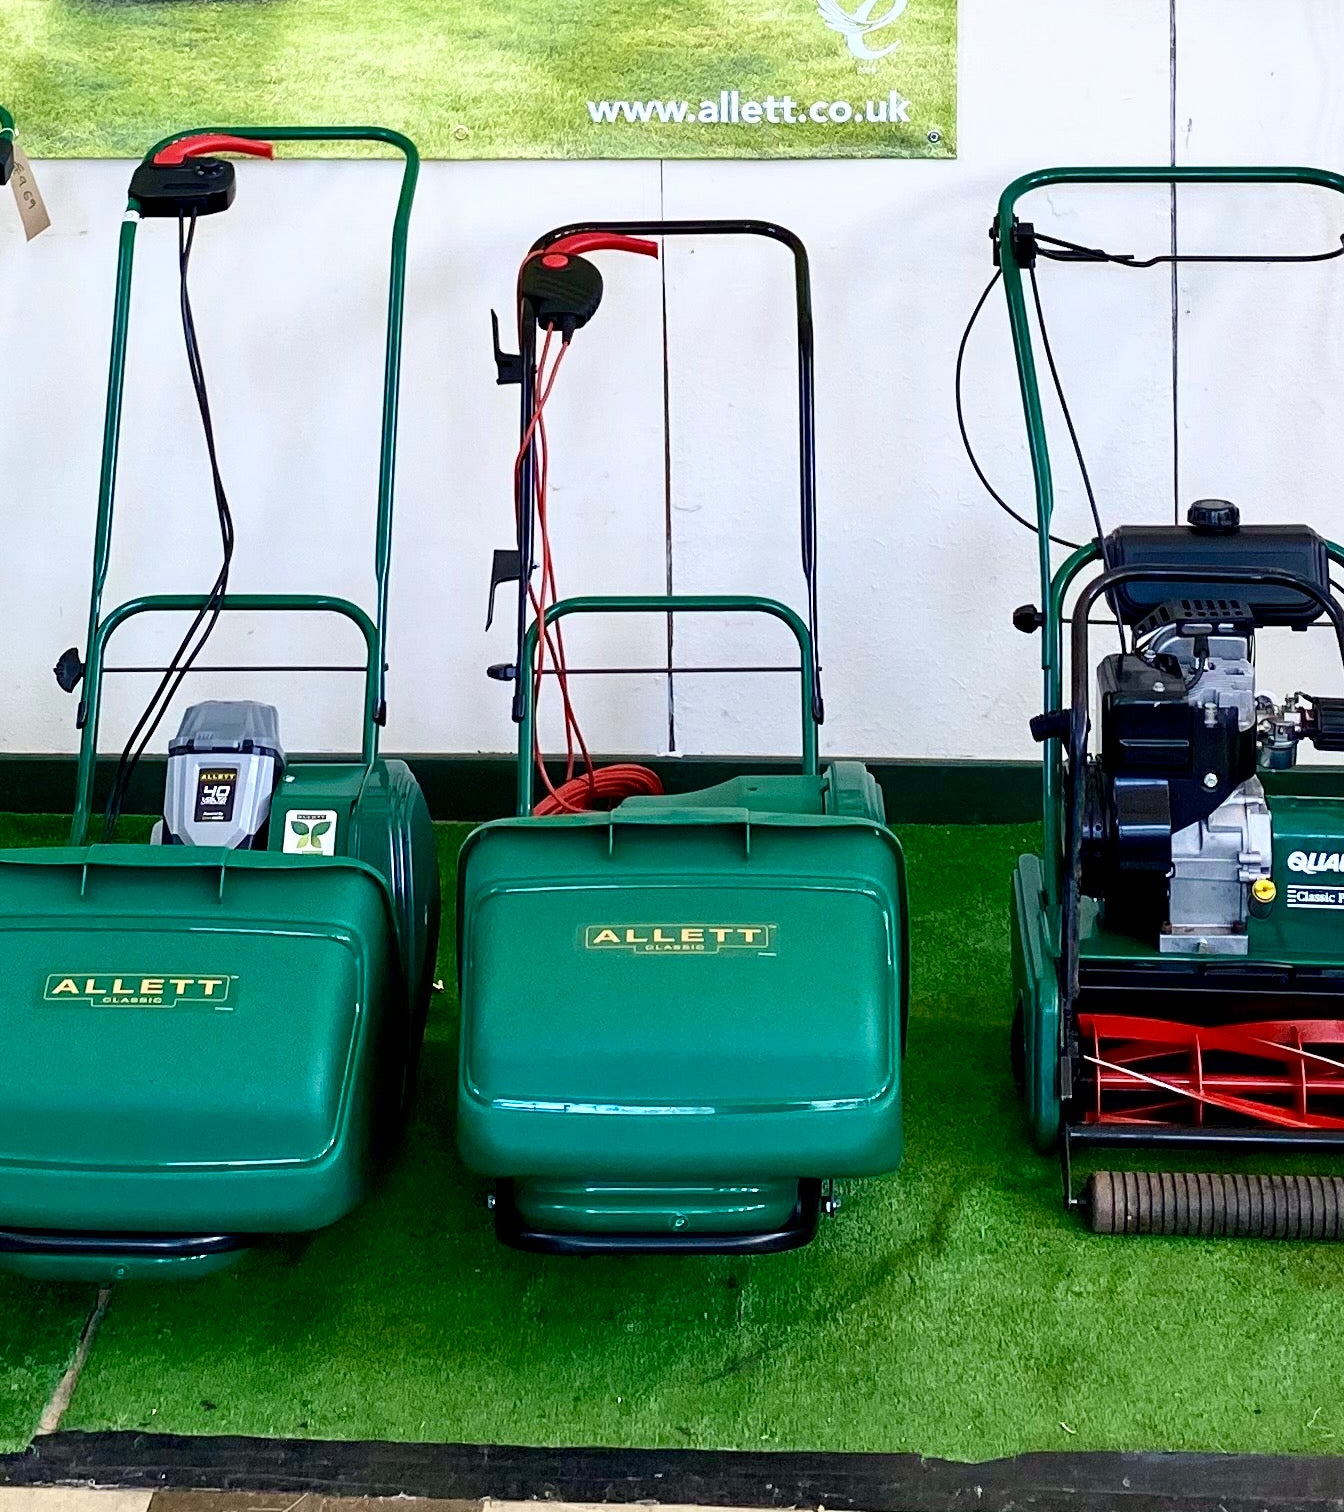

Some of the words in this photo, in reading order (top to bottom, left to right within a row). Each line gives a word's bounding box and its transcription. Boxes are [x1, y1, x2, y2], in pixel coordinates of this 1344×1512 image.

[586, 88, 913, 124] www.allett.co.uk
[204, 785, 231, 798] 40
[1296, 891, 1336, 903] Classic
[593, 928, 762, 944] ALLETT
[51, 978, 223, 996] ALLETT
